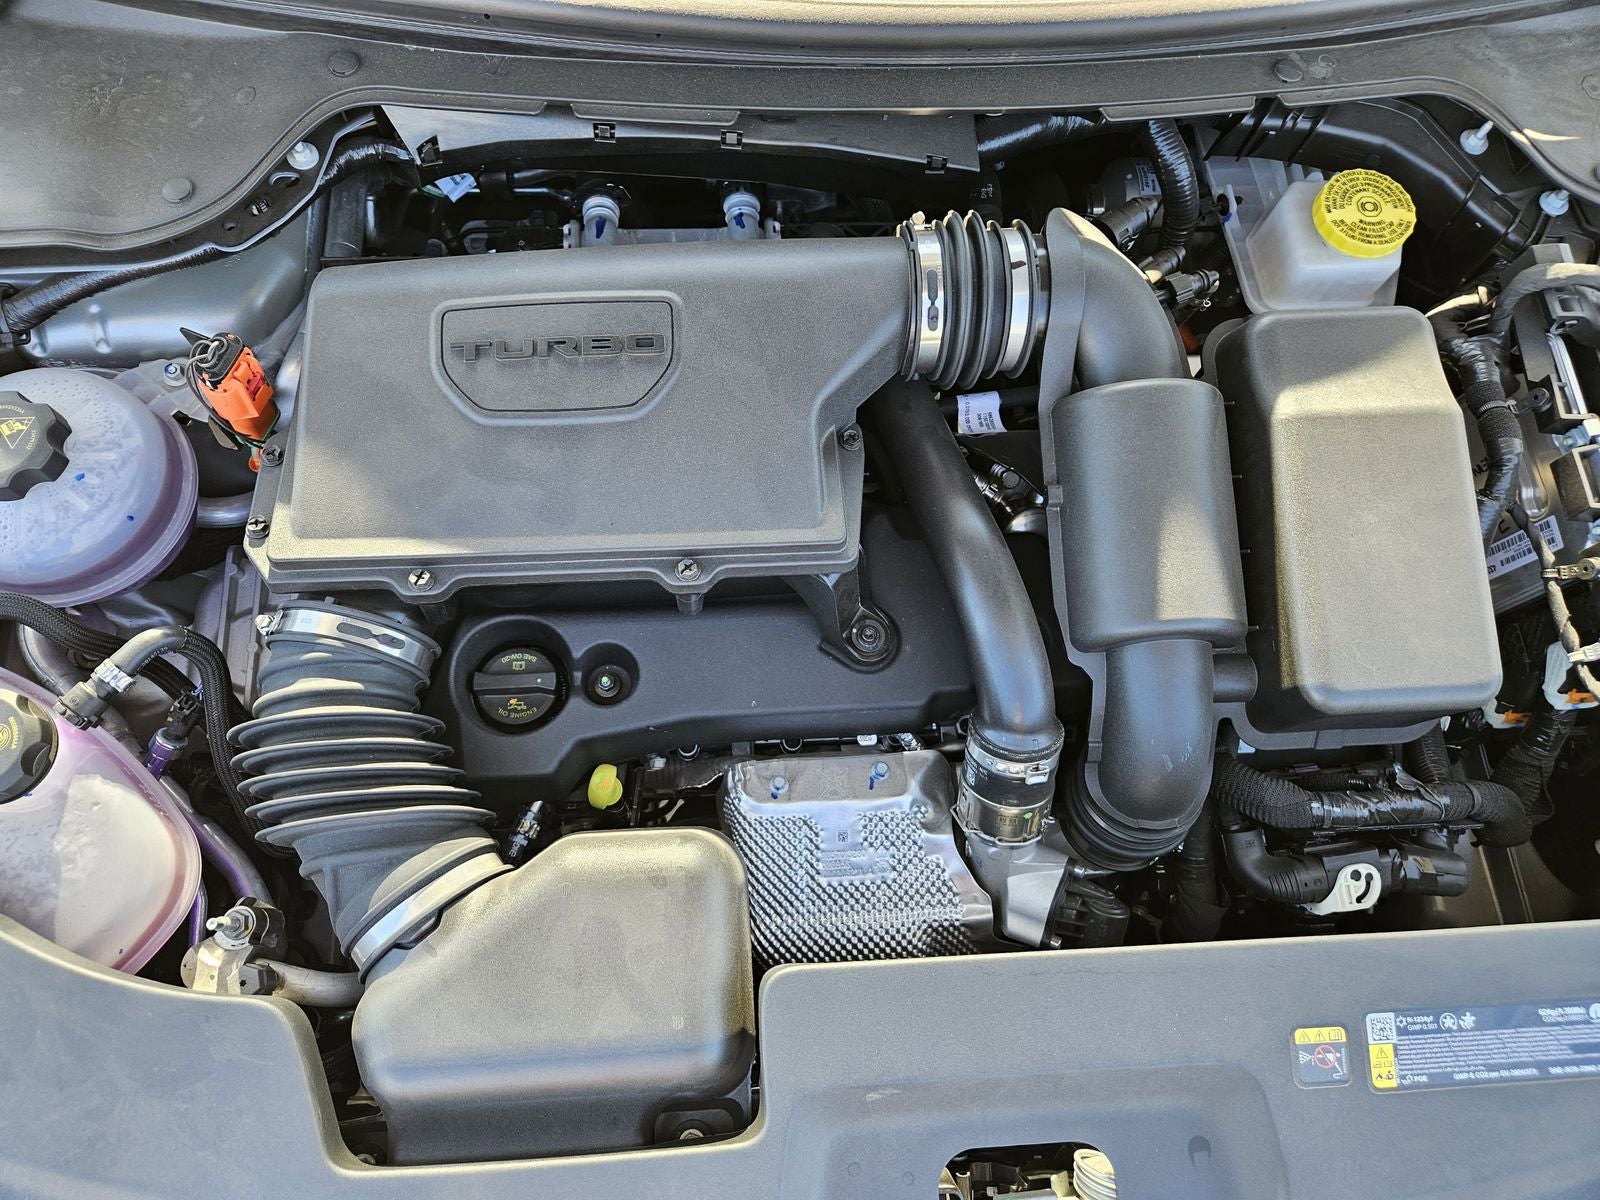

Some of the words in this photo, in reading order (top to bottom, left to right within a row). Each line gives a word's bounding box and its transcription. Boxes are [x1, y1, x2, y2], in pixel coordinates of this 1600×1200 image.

[1331, 219, 1340, 229] DOT
[1338, 218, 1356, 234] BEFORE
[1350, 221, 1368, 232] CLEAN
[450, 333, 665, 362] TURBO
[502, 652, 522, 664] 0W-20
[523, 653, 538, 663] SAE
[497, 706, 508, 717] OIL
[510, 706, 538, 719] ENGINE
